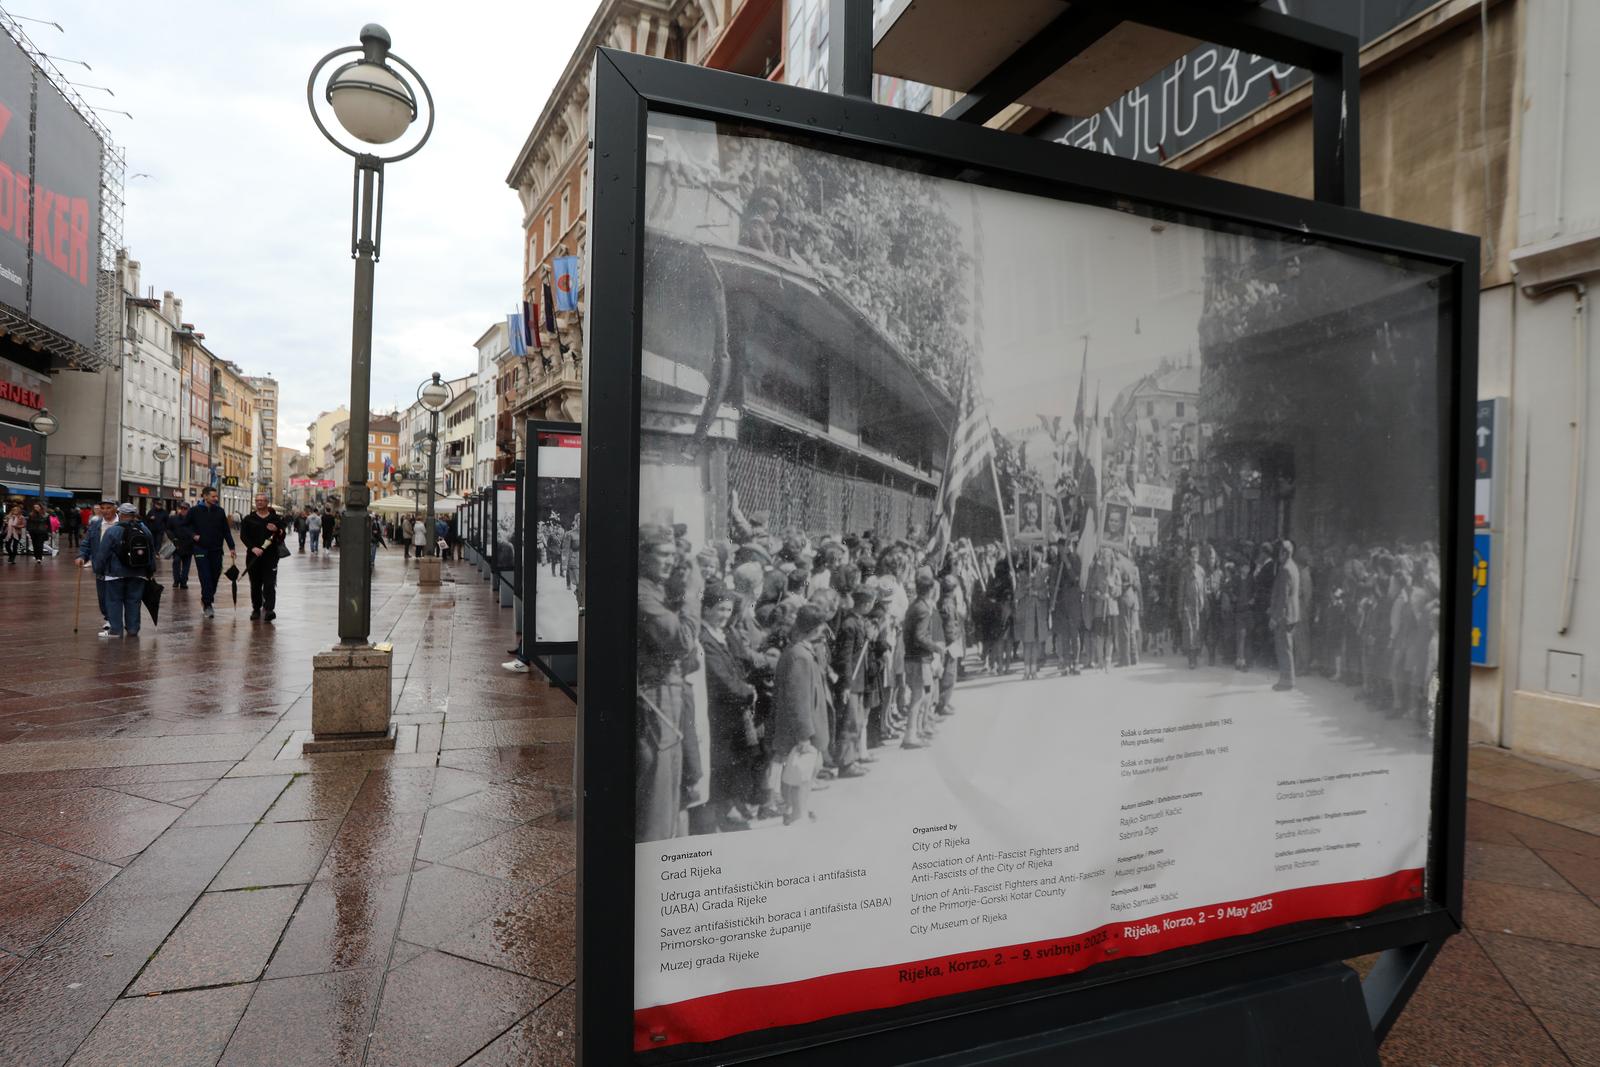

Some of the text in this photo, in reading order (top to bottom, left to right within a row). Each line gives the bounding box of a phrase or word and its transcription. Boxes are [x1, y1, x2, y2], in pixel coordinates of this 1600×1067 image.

[912, 824, 958, 836] Organised by
[660, 849, 713, 862] Organizatori
[912, 836, 970, 853] City of Rijeka
[912, 843, 1080, 870] Association of Anti-Fascist Fighters and
[660, 865, 722, 881] Grad Rijeka
[911, 858, 1053, 884] Anti-Fascists of the City of Rijeka
[660, 888, 701, 904] Udruga
[776, 874, 810, 888] boraca
[818, 868, 867, 882] antifašista
[911, 890, 938, 903] Union
[940, 889, 950, 900] of
[952, 883, 1002, 897] Anti-Fascist
[1004, 877, 1038, 892] Fighters
[1040, 876, 1056, 886] and
[660, 894, 768, 916] (UABA) Grada Rijeke
[910, 887, 1066, 916] of the Primorje-Gorski Kotar County
[660, 926, 692, 938] Savez
[694, 916, 765, 933] antifašističkih
[768, 911, 802, 924] boraca
[810, 901, 858, 917] antifašista
[860, 896, 892, 910] (SABA)
[910, 912, 1008, 936] City Museum of Rijeka
[1124, 924, 1160, 940] Rijeka,
[1163, 917, 1196, 931] Korzo,
[1198, 912, 1205, 923] 2
[1217, 908, 1224, 920] 9
[1226, 904, 1248, 920] May
[1250, 898, 1273, 914] 2023
[660, 920, 812, 951] Primorsko-goranske županije
[660, 950, 760, 973] Muzej grada Rijeke
[899, 964, 944, 984] Rijeka,
[949, 958, 990, 974] Korzo,
[994, 954, 1006, 966] 2.
[1022, 950, 1032, 960] 9.
[1036, 941, 1081, 958] svibnja
